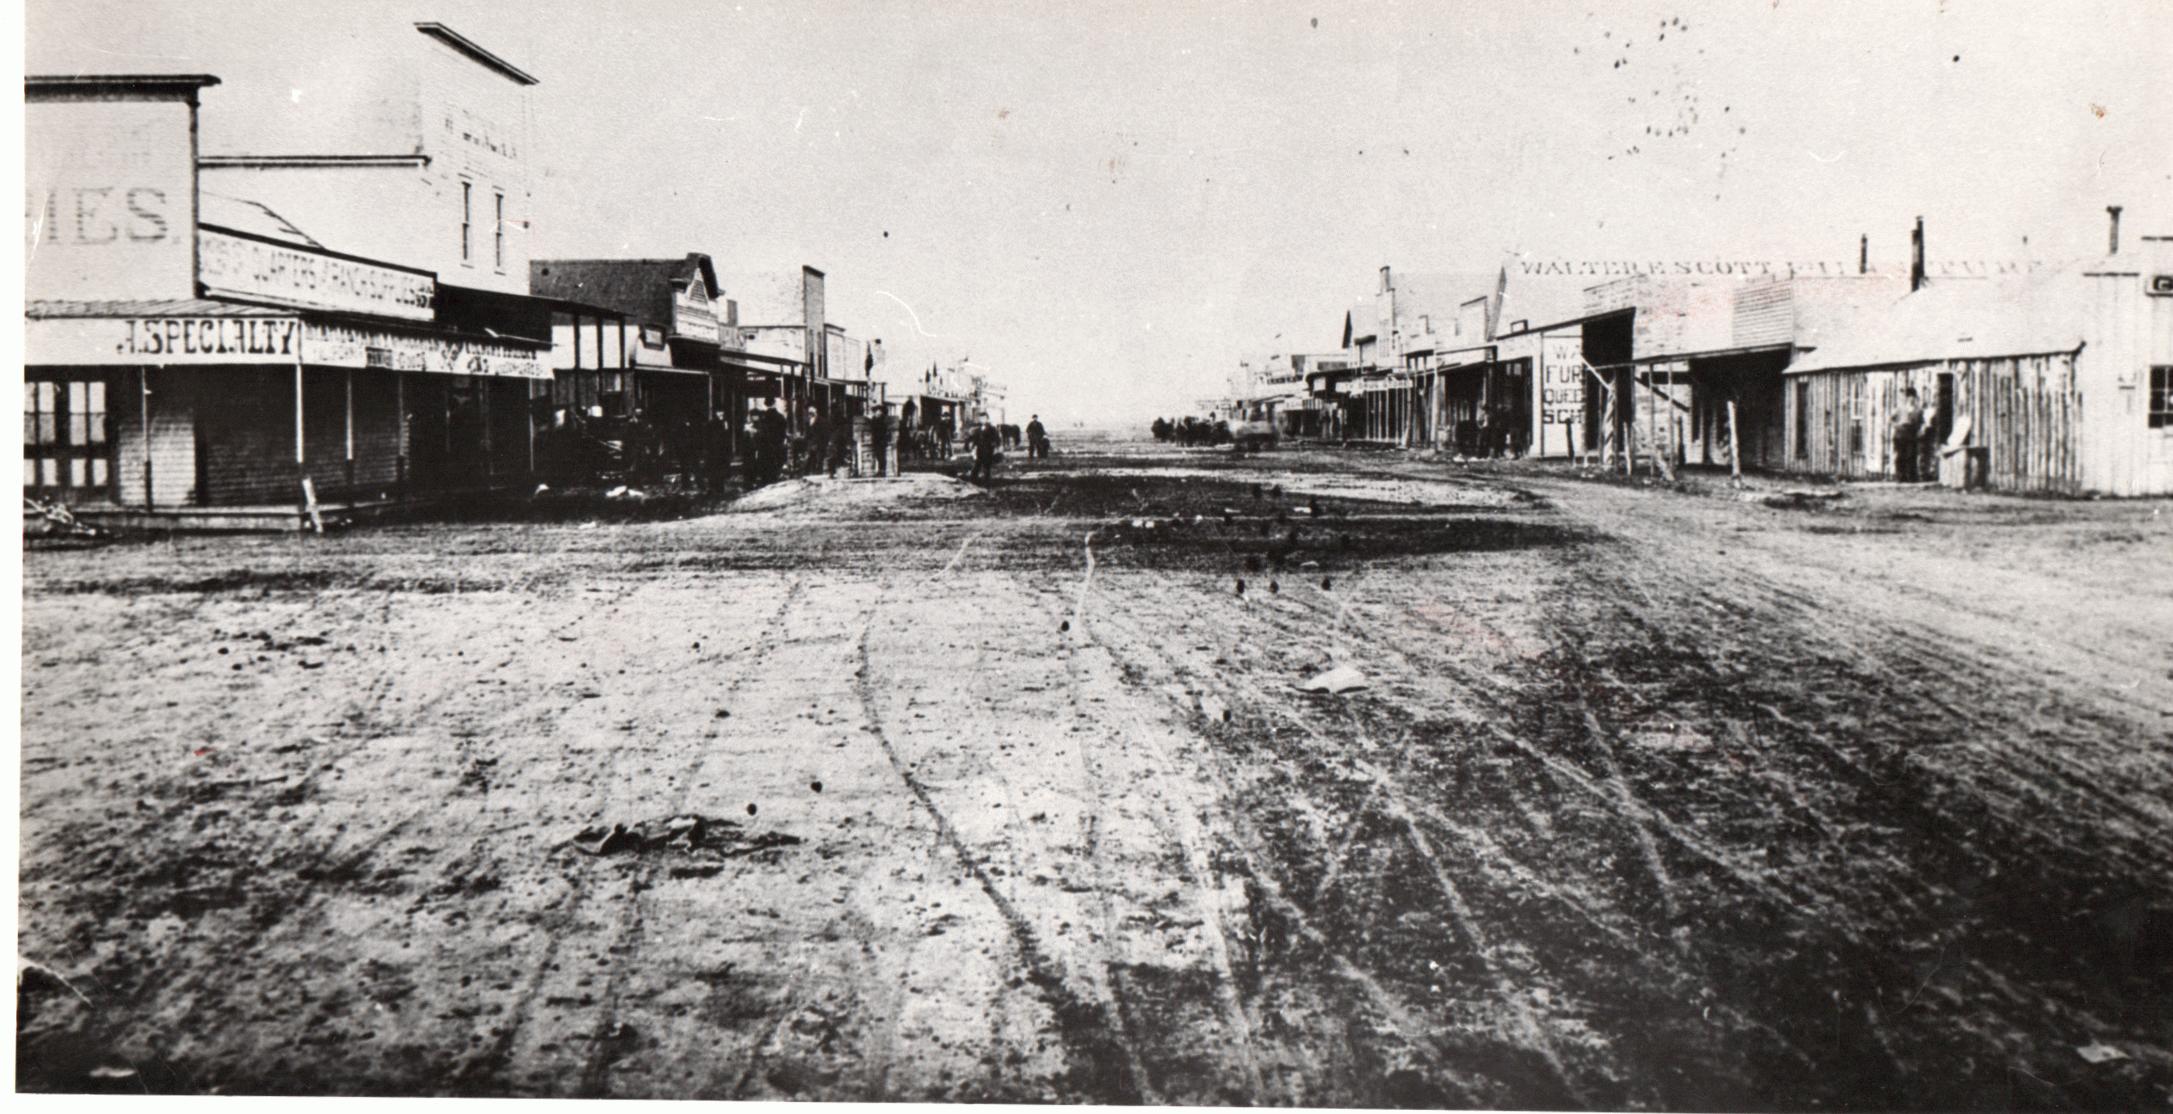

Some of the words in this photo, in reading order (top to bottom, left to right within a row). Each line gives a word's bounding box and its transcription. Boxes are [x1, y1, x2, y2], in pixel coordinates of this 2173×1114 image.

[25, 186, 181, 246] IES.
[1674, 260, 1772, 275] SCOTT
[141, 319, 297, 355] SPECIALTY
